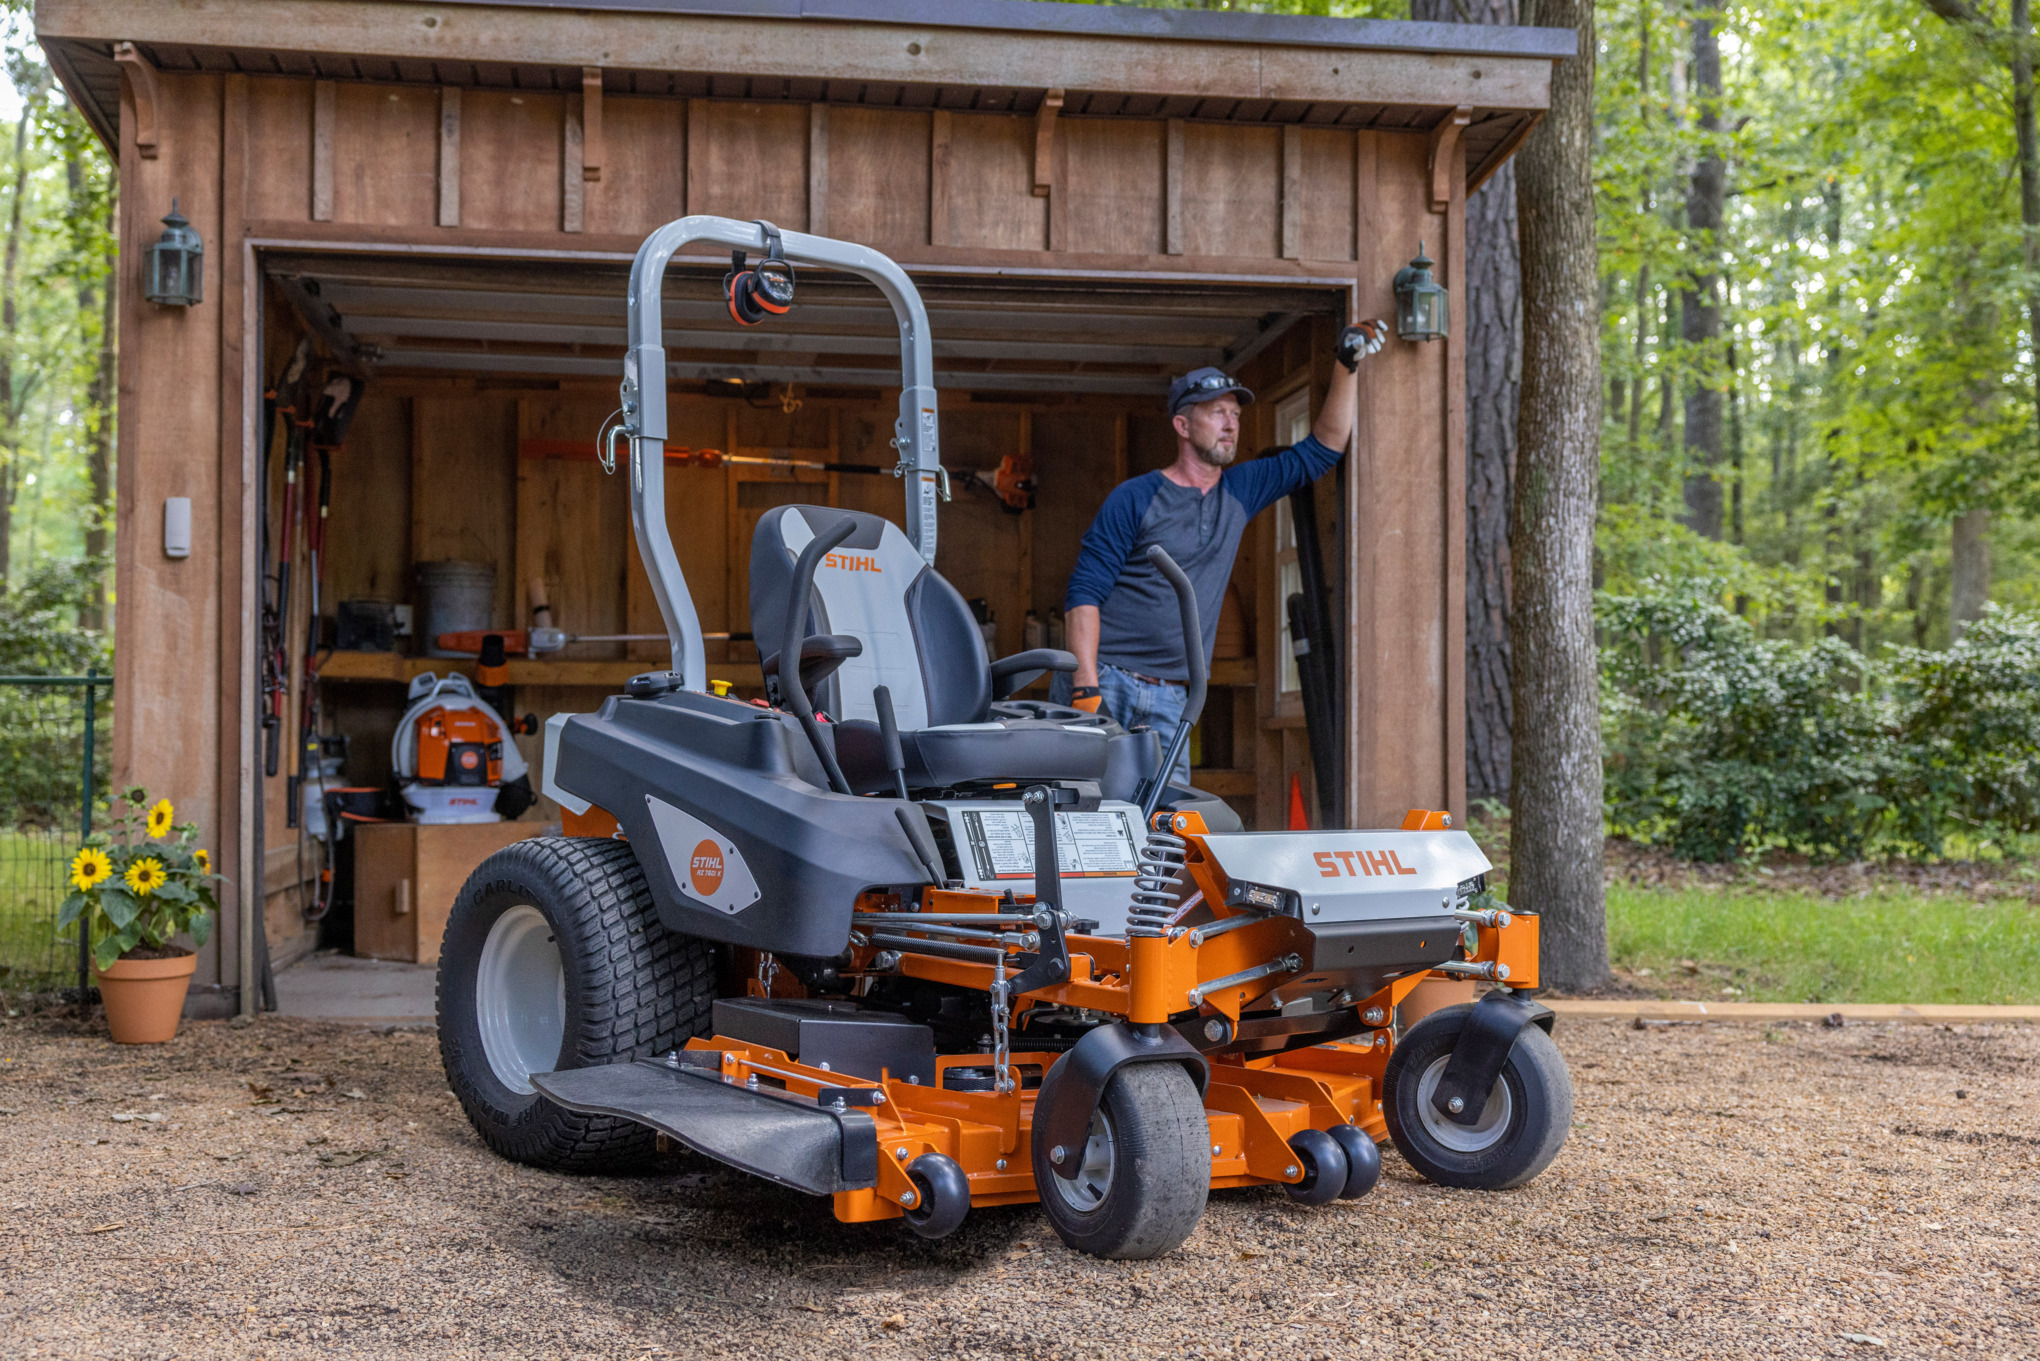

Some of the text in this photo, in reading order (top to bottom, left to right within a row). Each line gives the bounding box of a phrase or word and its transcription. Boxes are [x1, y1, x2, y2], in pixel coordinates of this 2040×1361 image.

[825, 552, 882, 573] STIHL
[692, 856, 722, 868] STIHL
[1313, 850, 1417, 877] STIHL
